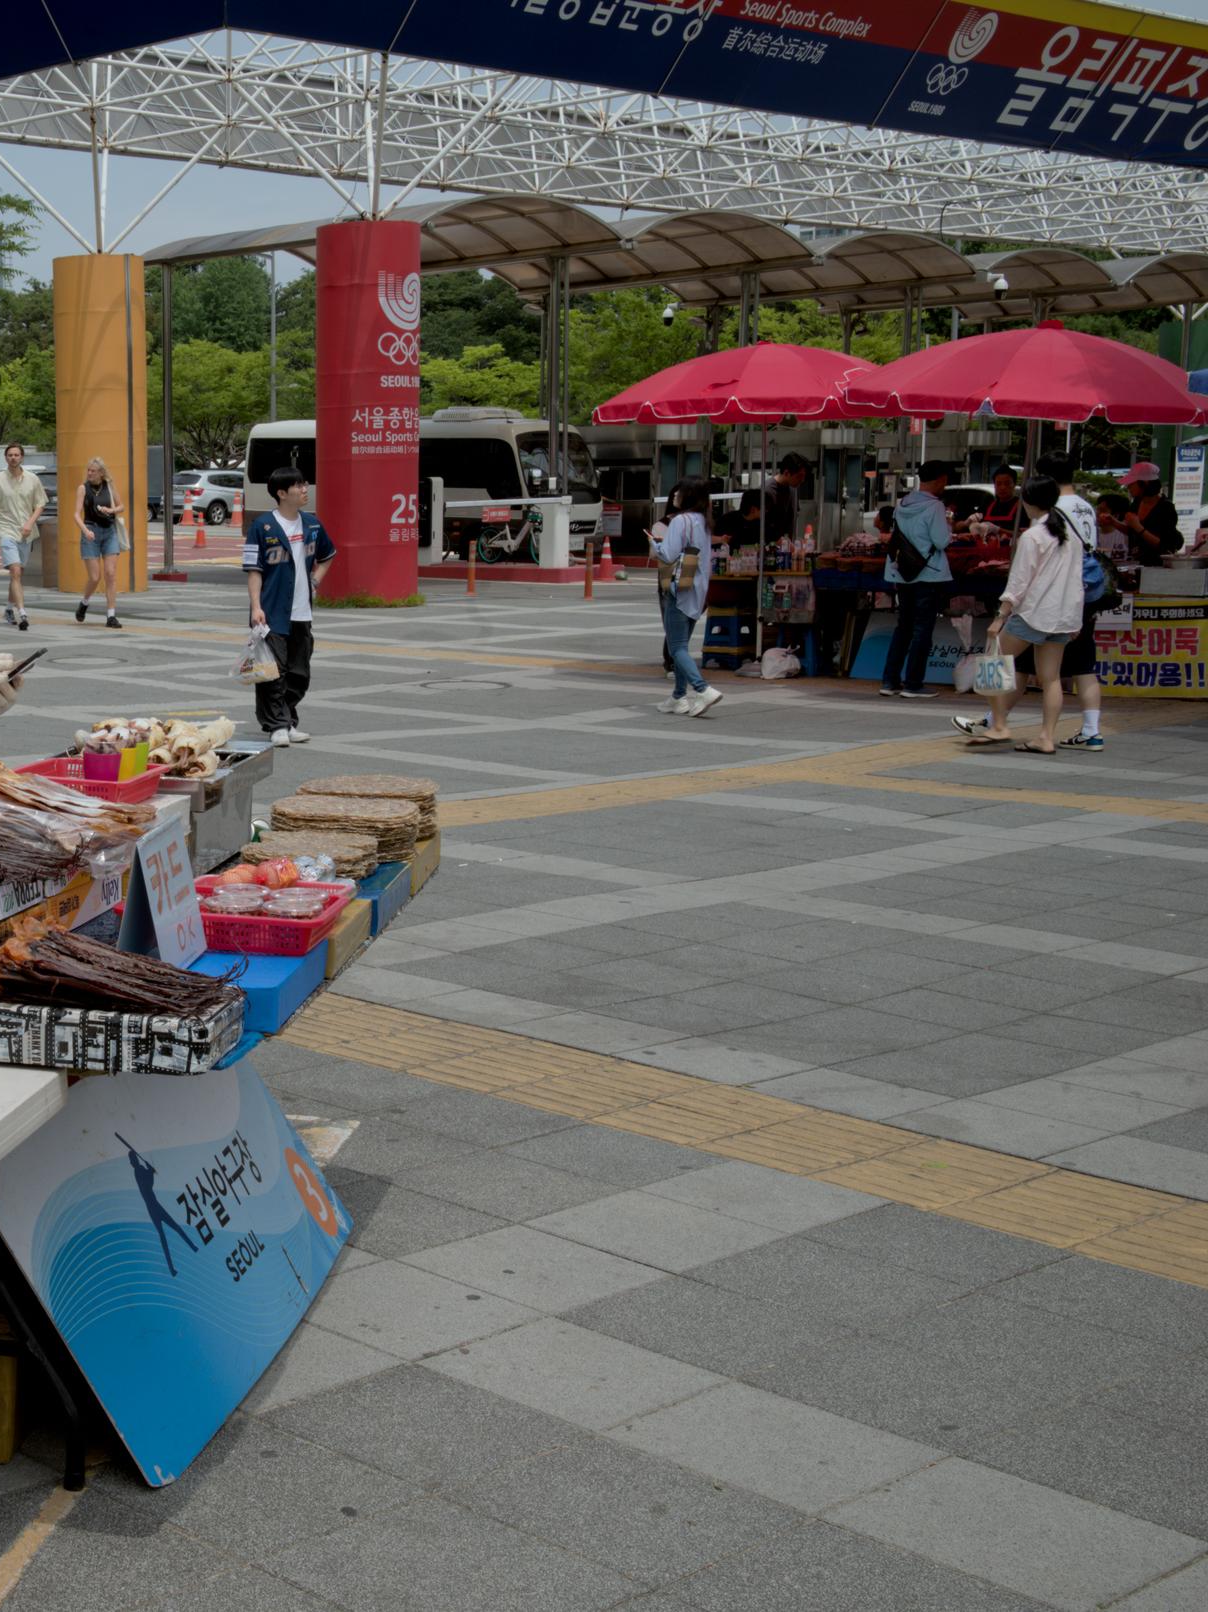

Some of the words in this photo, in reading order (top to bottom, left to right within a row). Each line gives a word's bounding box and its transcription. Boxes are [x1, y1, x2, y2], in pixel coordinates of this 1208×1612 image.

[740, 0, 779, 20] Seoul
[777, 3, 819, 28] Sports
[818, 12, 872, 39] Complex
[352, 407, 419, 429] 서울종합운
[352, 431, 382, 442] Seoul
[385, 431, 412, 444] Sports
[391, 493, 417, 524] 25
[101, 876, 121, 906] Kelly
[146, 841, 191, 914] 카드
[176, 1129, 262, 1246] 잠실야구장
[225, 1230, 265, 1282] SEOUL
